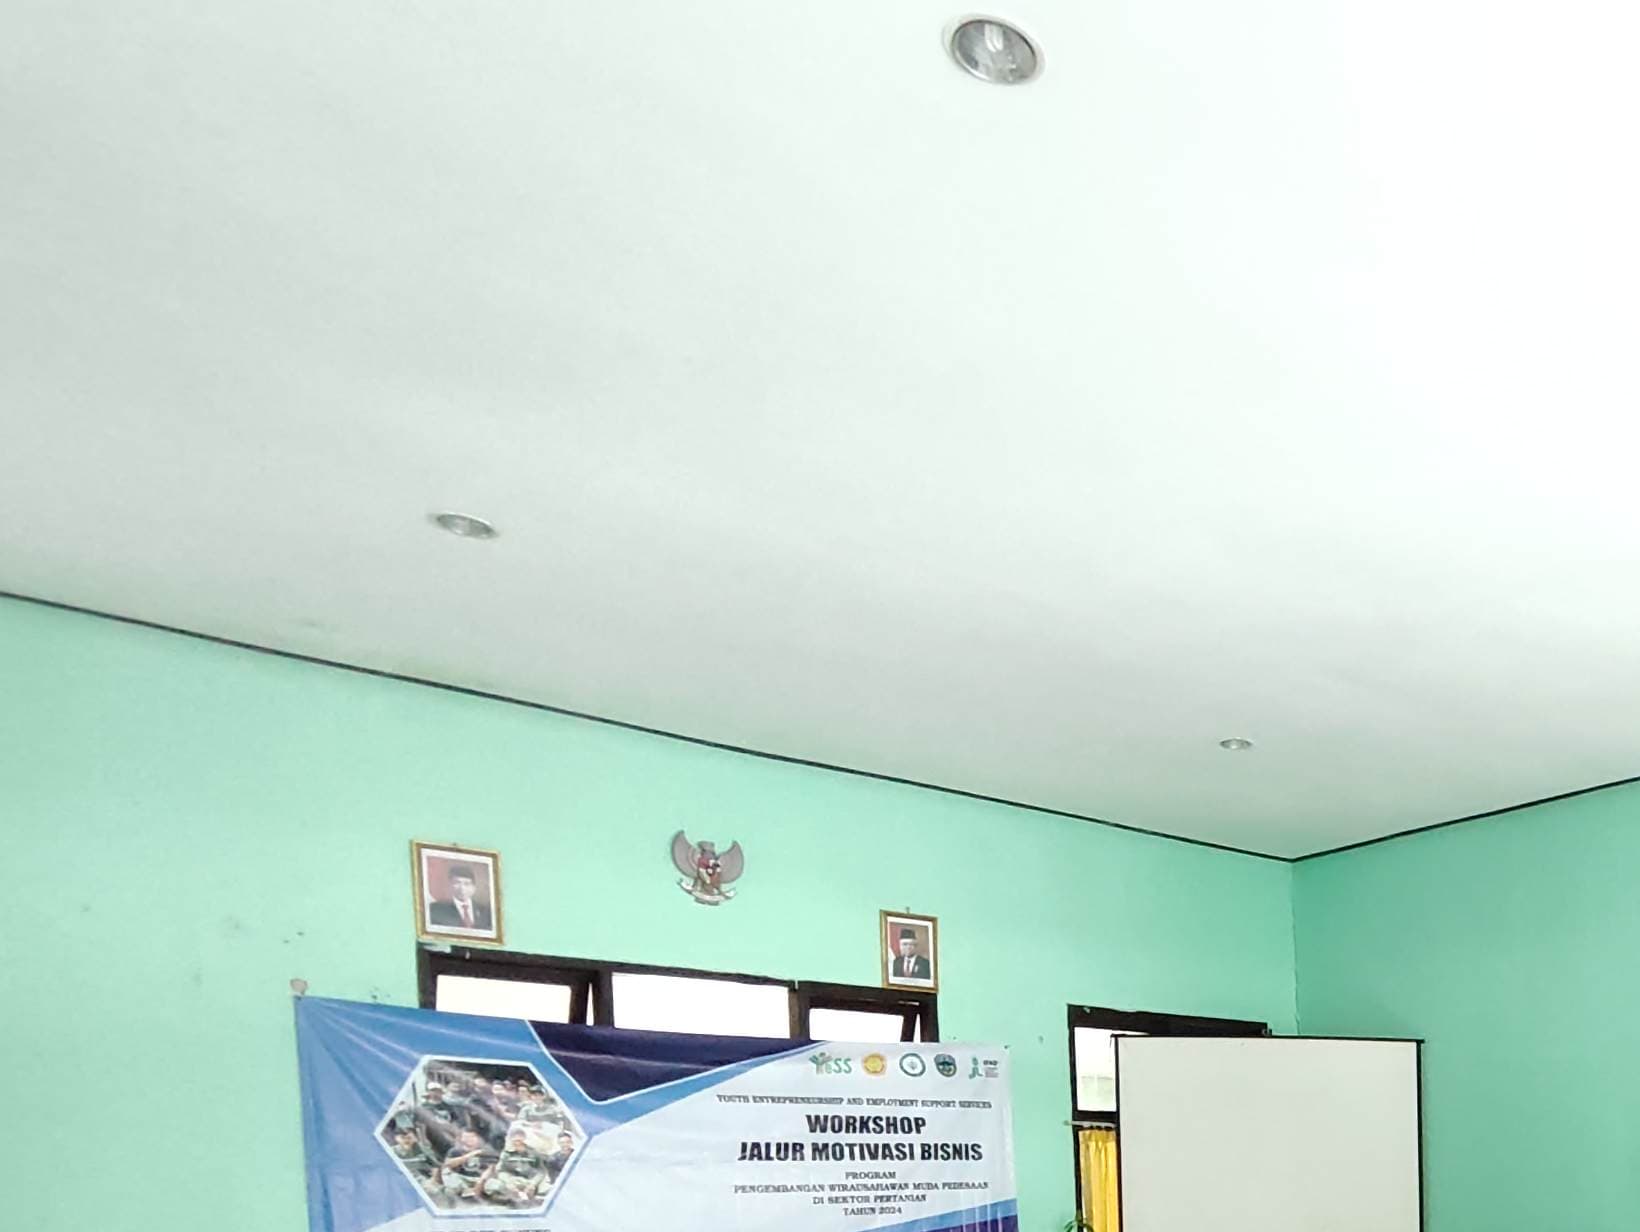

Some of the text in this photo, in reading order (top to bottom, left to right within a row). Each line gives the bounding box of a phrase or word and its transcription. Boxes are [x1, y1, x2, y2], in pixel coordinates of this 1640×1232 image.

[716, 1094, 750, 1104] YOUTH
[846, 1097, 864, 1106] AND
[866, 1098, 919, 1108] EMPLOYMENT
[921, 1099, 956, 1108] SUPPORT
[805, 1114, 927, 1135] WORKSHOP
[737, 1141, 983, 1162] JALUR MOTIVASI BISNIS
[845, 1171, 897, 1180] PROGRAM
[733, 1183, 825, 1194] PENGEMBANGAN
[828, 1182, 910, 1193] WIRAUSAHAWAN
[912, 1181, 940, 1191] MUDA
[812, 1194, 927, 1205] DI SEKTOR PERTANIAN
[843, 1206, 902, 1216] TAHUN 2024
